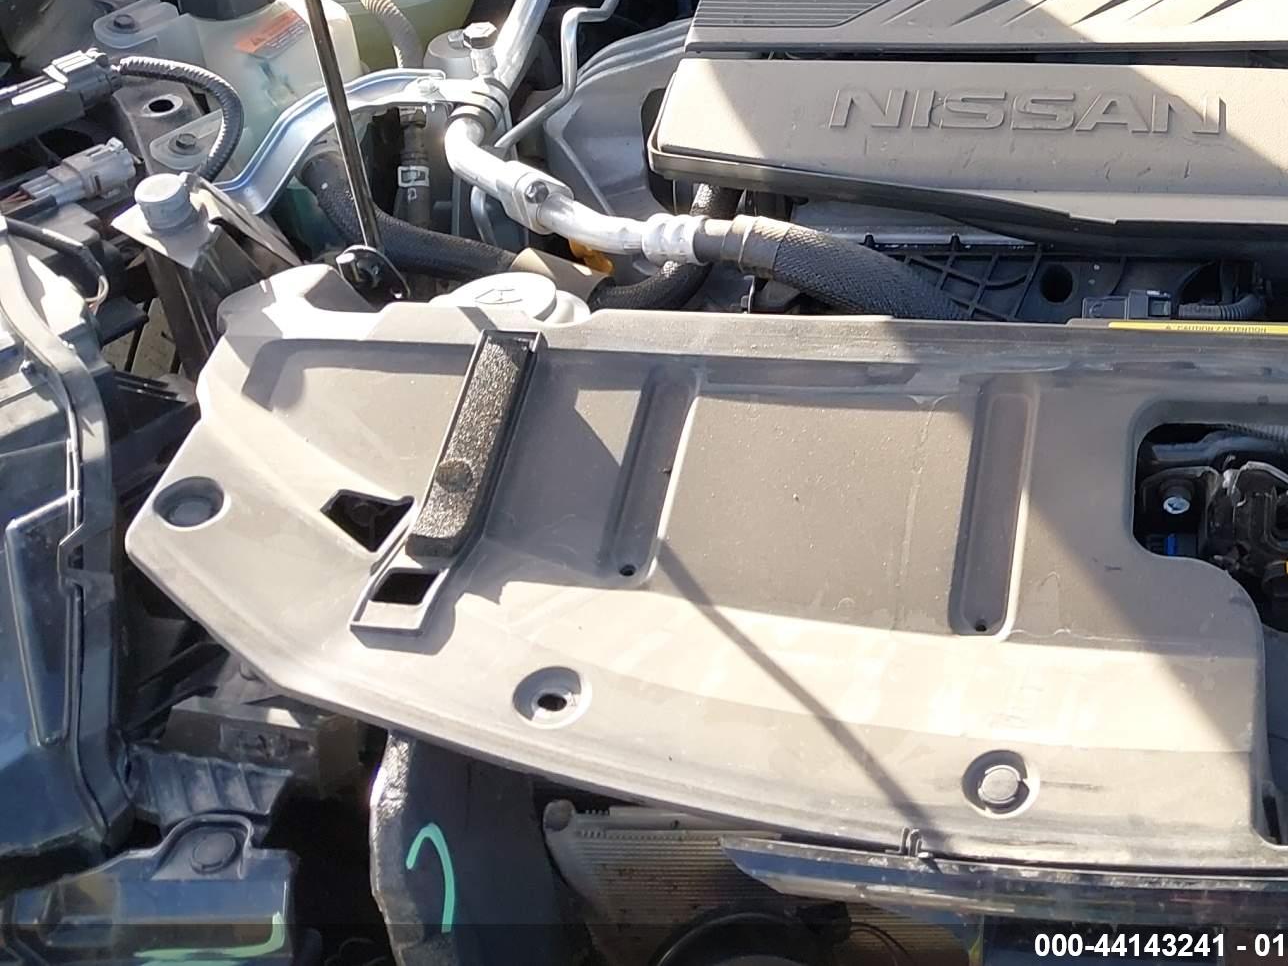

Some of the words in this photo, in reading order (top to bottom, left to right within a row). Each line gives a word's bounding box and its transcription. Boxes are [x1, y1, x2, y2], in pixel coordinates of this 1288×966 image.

[826, 89, 1229, 135] NISSAN
[1176, 324, 1214, 332] CAUTION
[1221, 326, 1267, 334] ATTENTION
